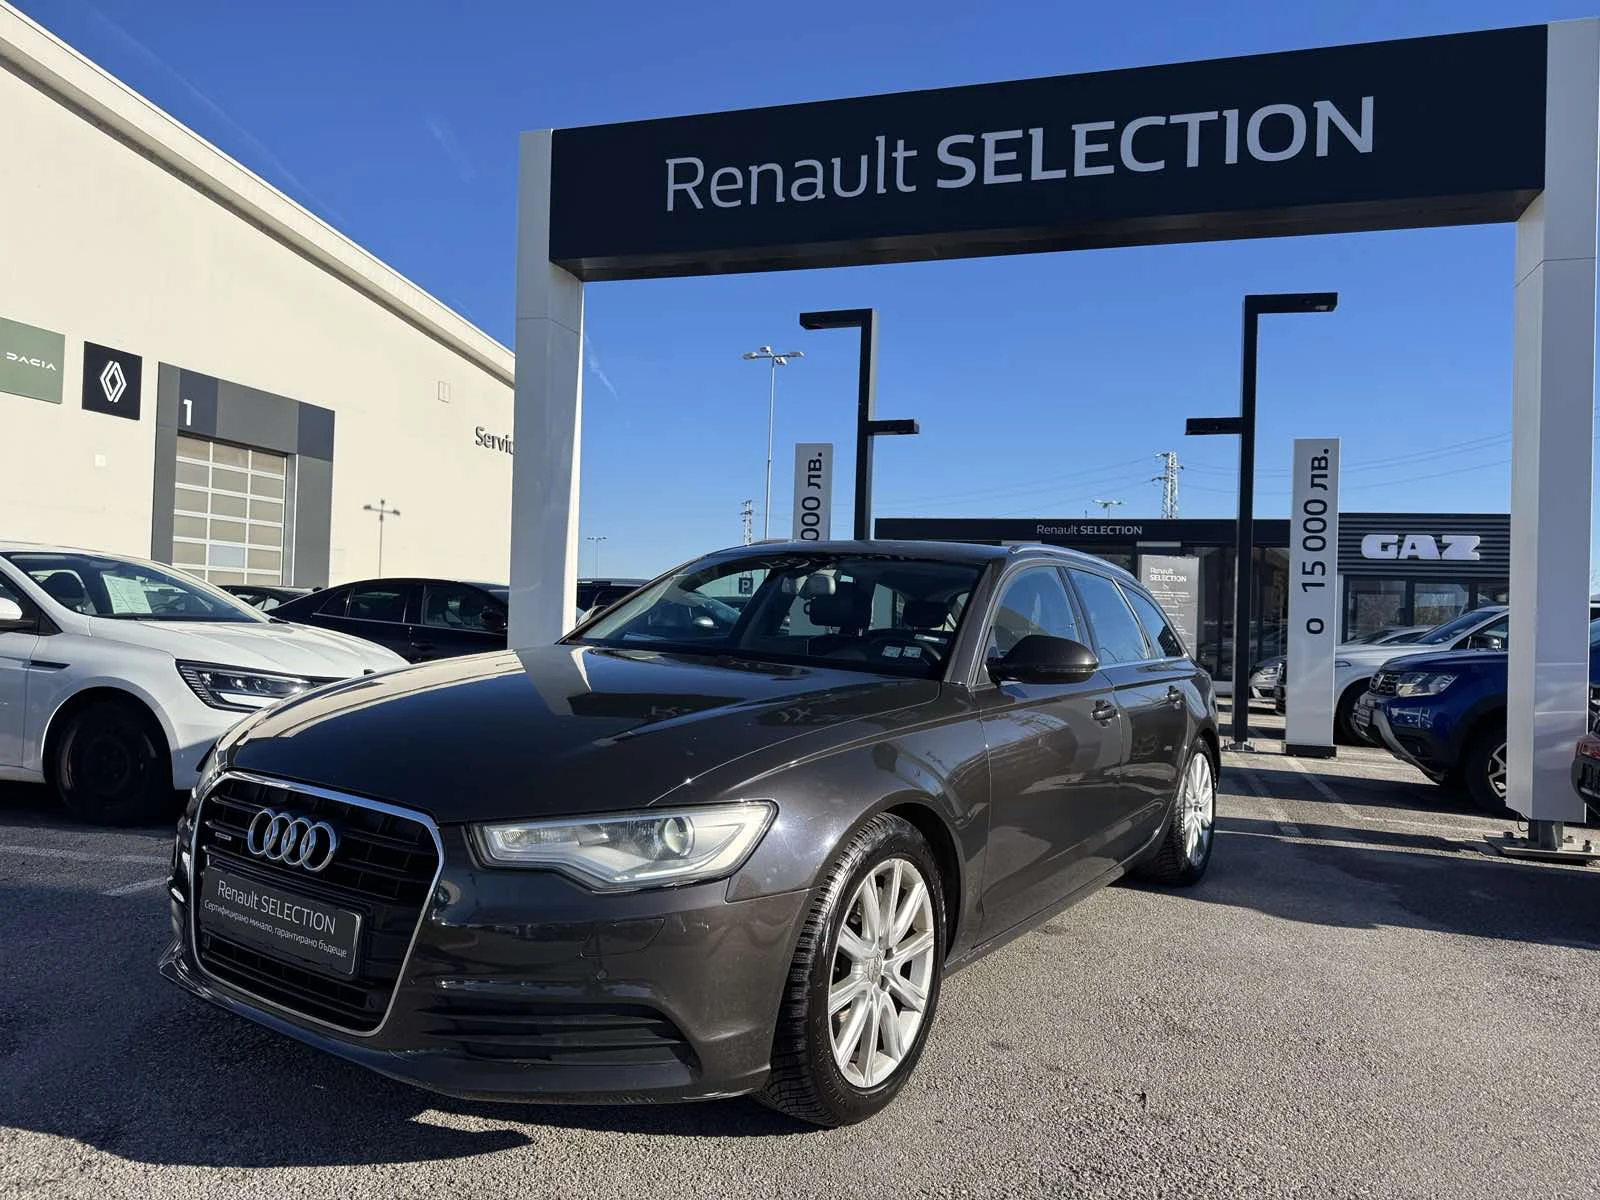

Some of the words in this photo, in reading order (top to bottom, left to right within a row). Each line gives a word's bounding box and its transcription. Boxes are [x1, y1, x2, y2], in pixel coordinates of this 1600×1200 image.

[666, 135, 918, 212] Renault
[936, 95, 1375, 189] SELECTION
[6, 352, 57, 372] DACIA
[183, 398, 193, 426] 1
[807, 451, 823, 490] лв.
[1310, 448, 1330, 491] лв.
[1036, 524, 1078, 535] Renault
[1080, 525, 1143, 535] SELECTION
[1302, 499, 1328, 552] 000
[1360, 534, 1481, 560] GAZ
[741, 580, 751, 593] P
[1301, 560, 1326, 593] 15
[217, 879, 260, 910] Renault
[260, 895, 336, 935] SELECTION
[204, 899, 250, 925] Сертифицирано
[249, 917, 274, 934] минало,
[274, 927, 318, 949] гарантирано
[318, 939, 348, 958] бъдеще
